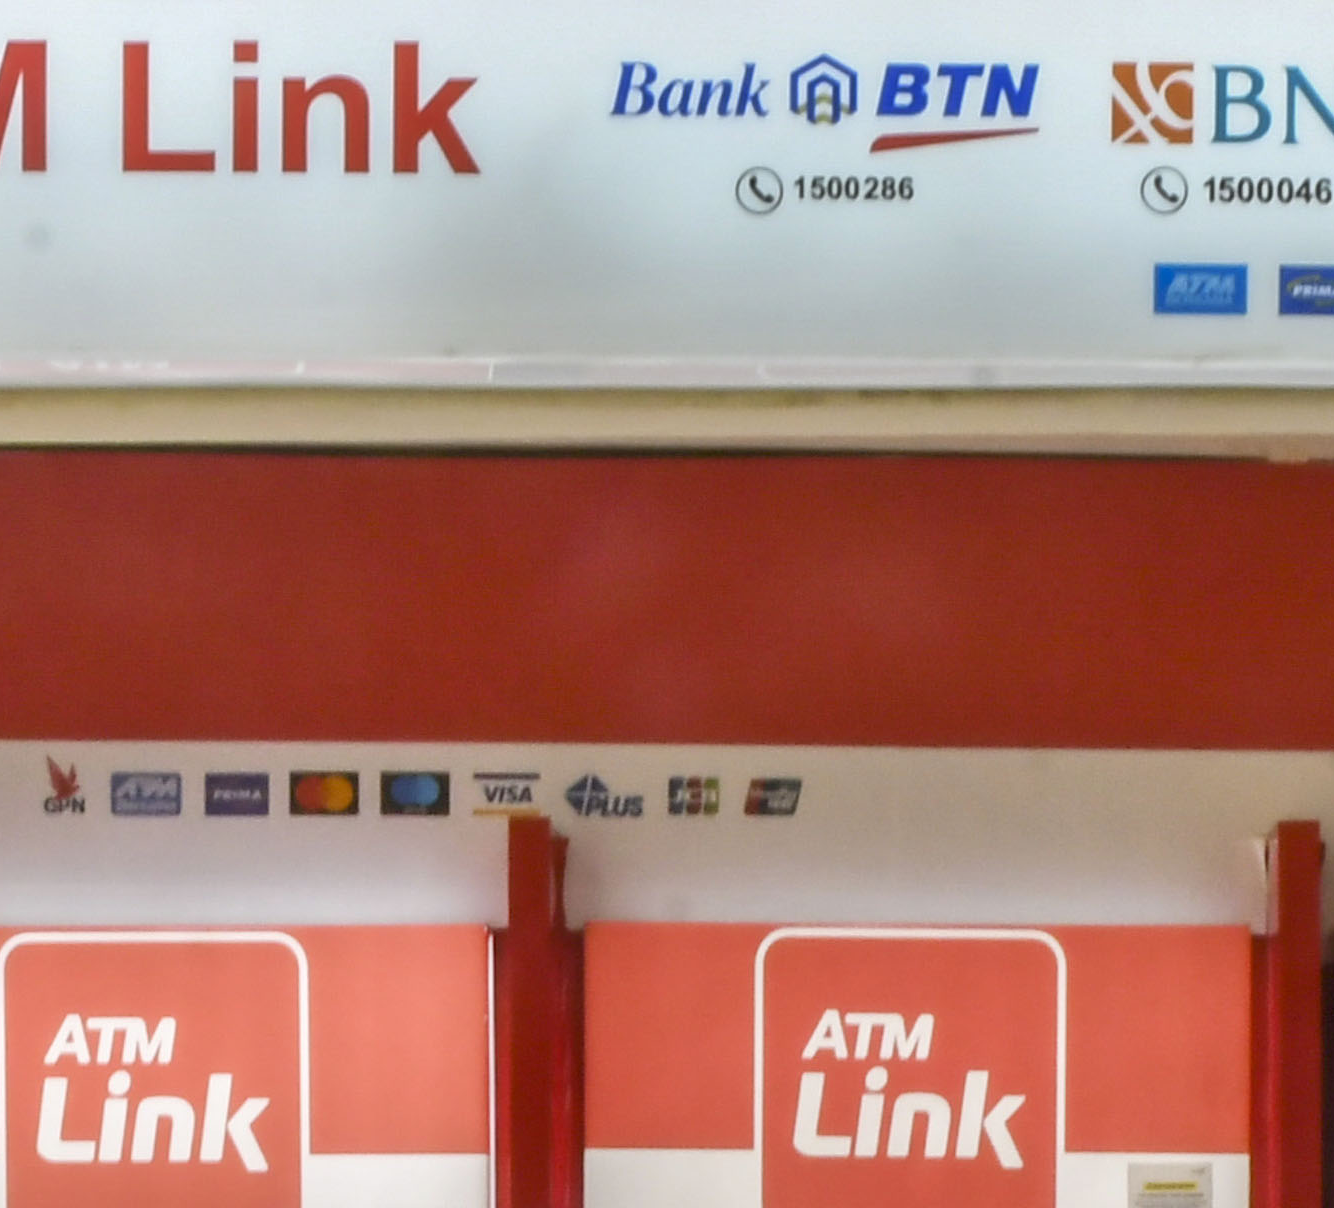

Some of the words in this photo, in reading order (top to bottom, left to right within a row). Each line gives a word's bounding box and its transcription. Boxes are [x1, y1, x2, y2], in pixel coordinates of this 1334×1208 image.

[122, 40, 480, 174] Link
[610, 61, 770, 117] Bank
[876, 62, 1040, 118] BTN
[794, 176, 914, 201] 1500286
[1203, 176, 1333, 204] 1500046
[483, 785, 533, 803] VISA
[588, 793, 644, 817] PLUS
[44, 1013, 176, 1066] ATM
[802, 1008, 934, 1061] ATM
[36, 1069, 270, 1173] Link
[793, 1065, 1027, 1170] Link
